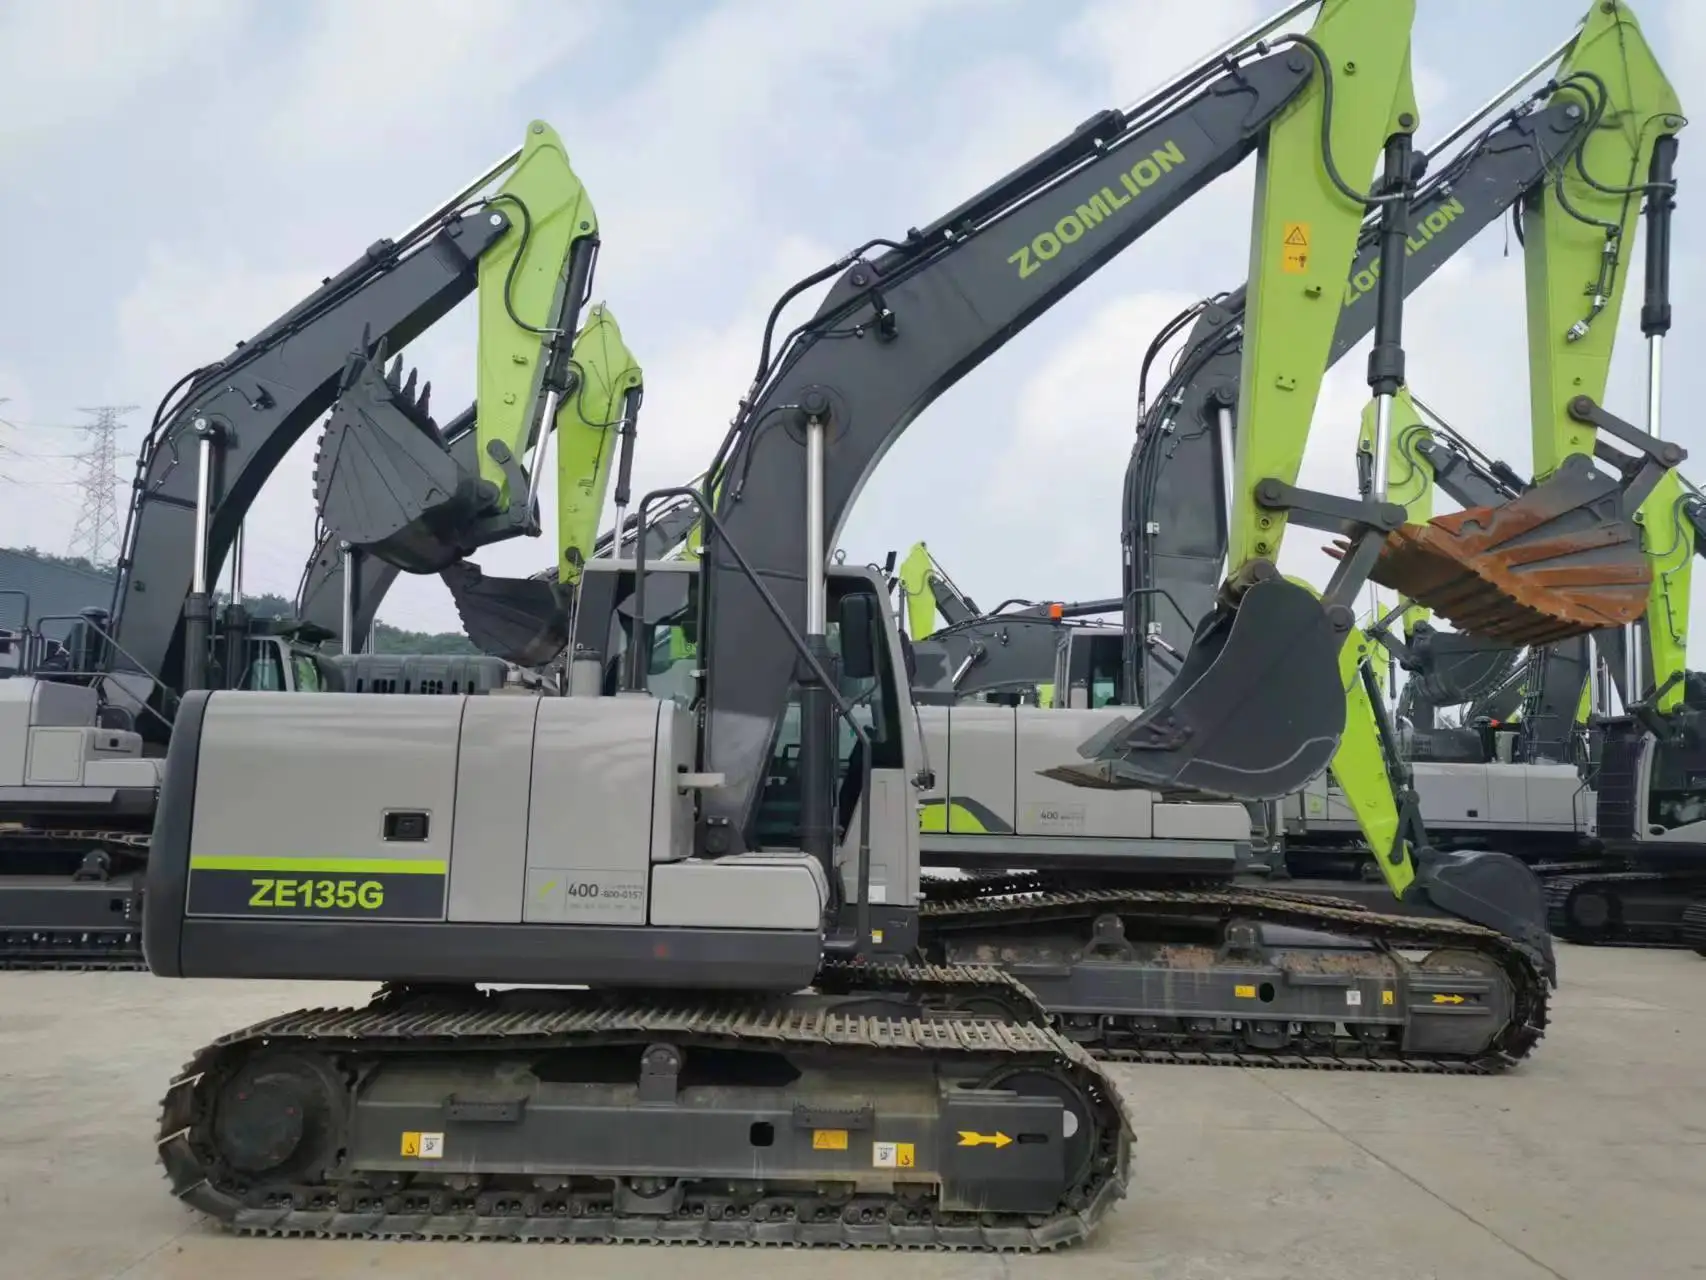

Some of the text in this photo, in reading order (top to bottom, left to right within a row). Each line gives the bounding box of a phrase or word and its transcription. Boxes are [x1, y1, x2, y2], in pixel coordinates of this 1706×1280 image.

[1007, 140, 1186, 279] ZOOMLION
[1344, 196, 1465, 306] ZOLION
[248, 878, 384, 909] ZE135G
[568, 883, 599, 898] 400
